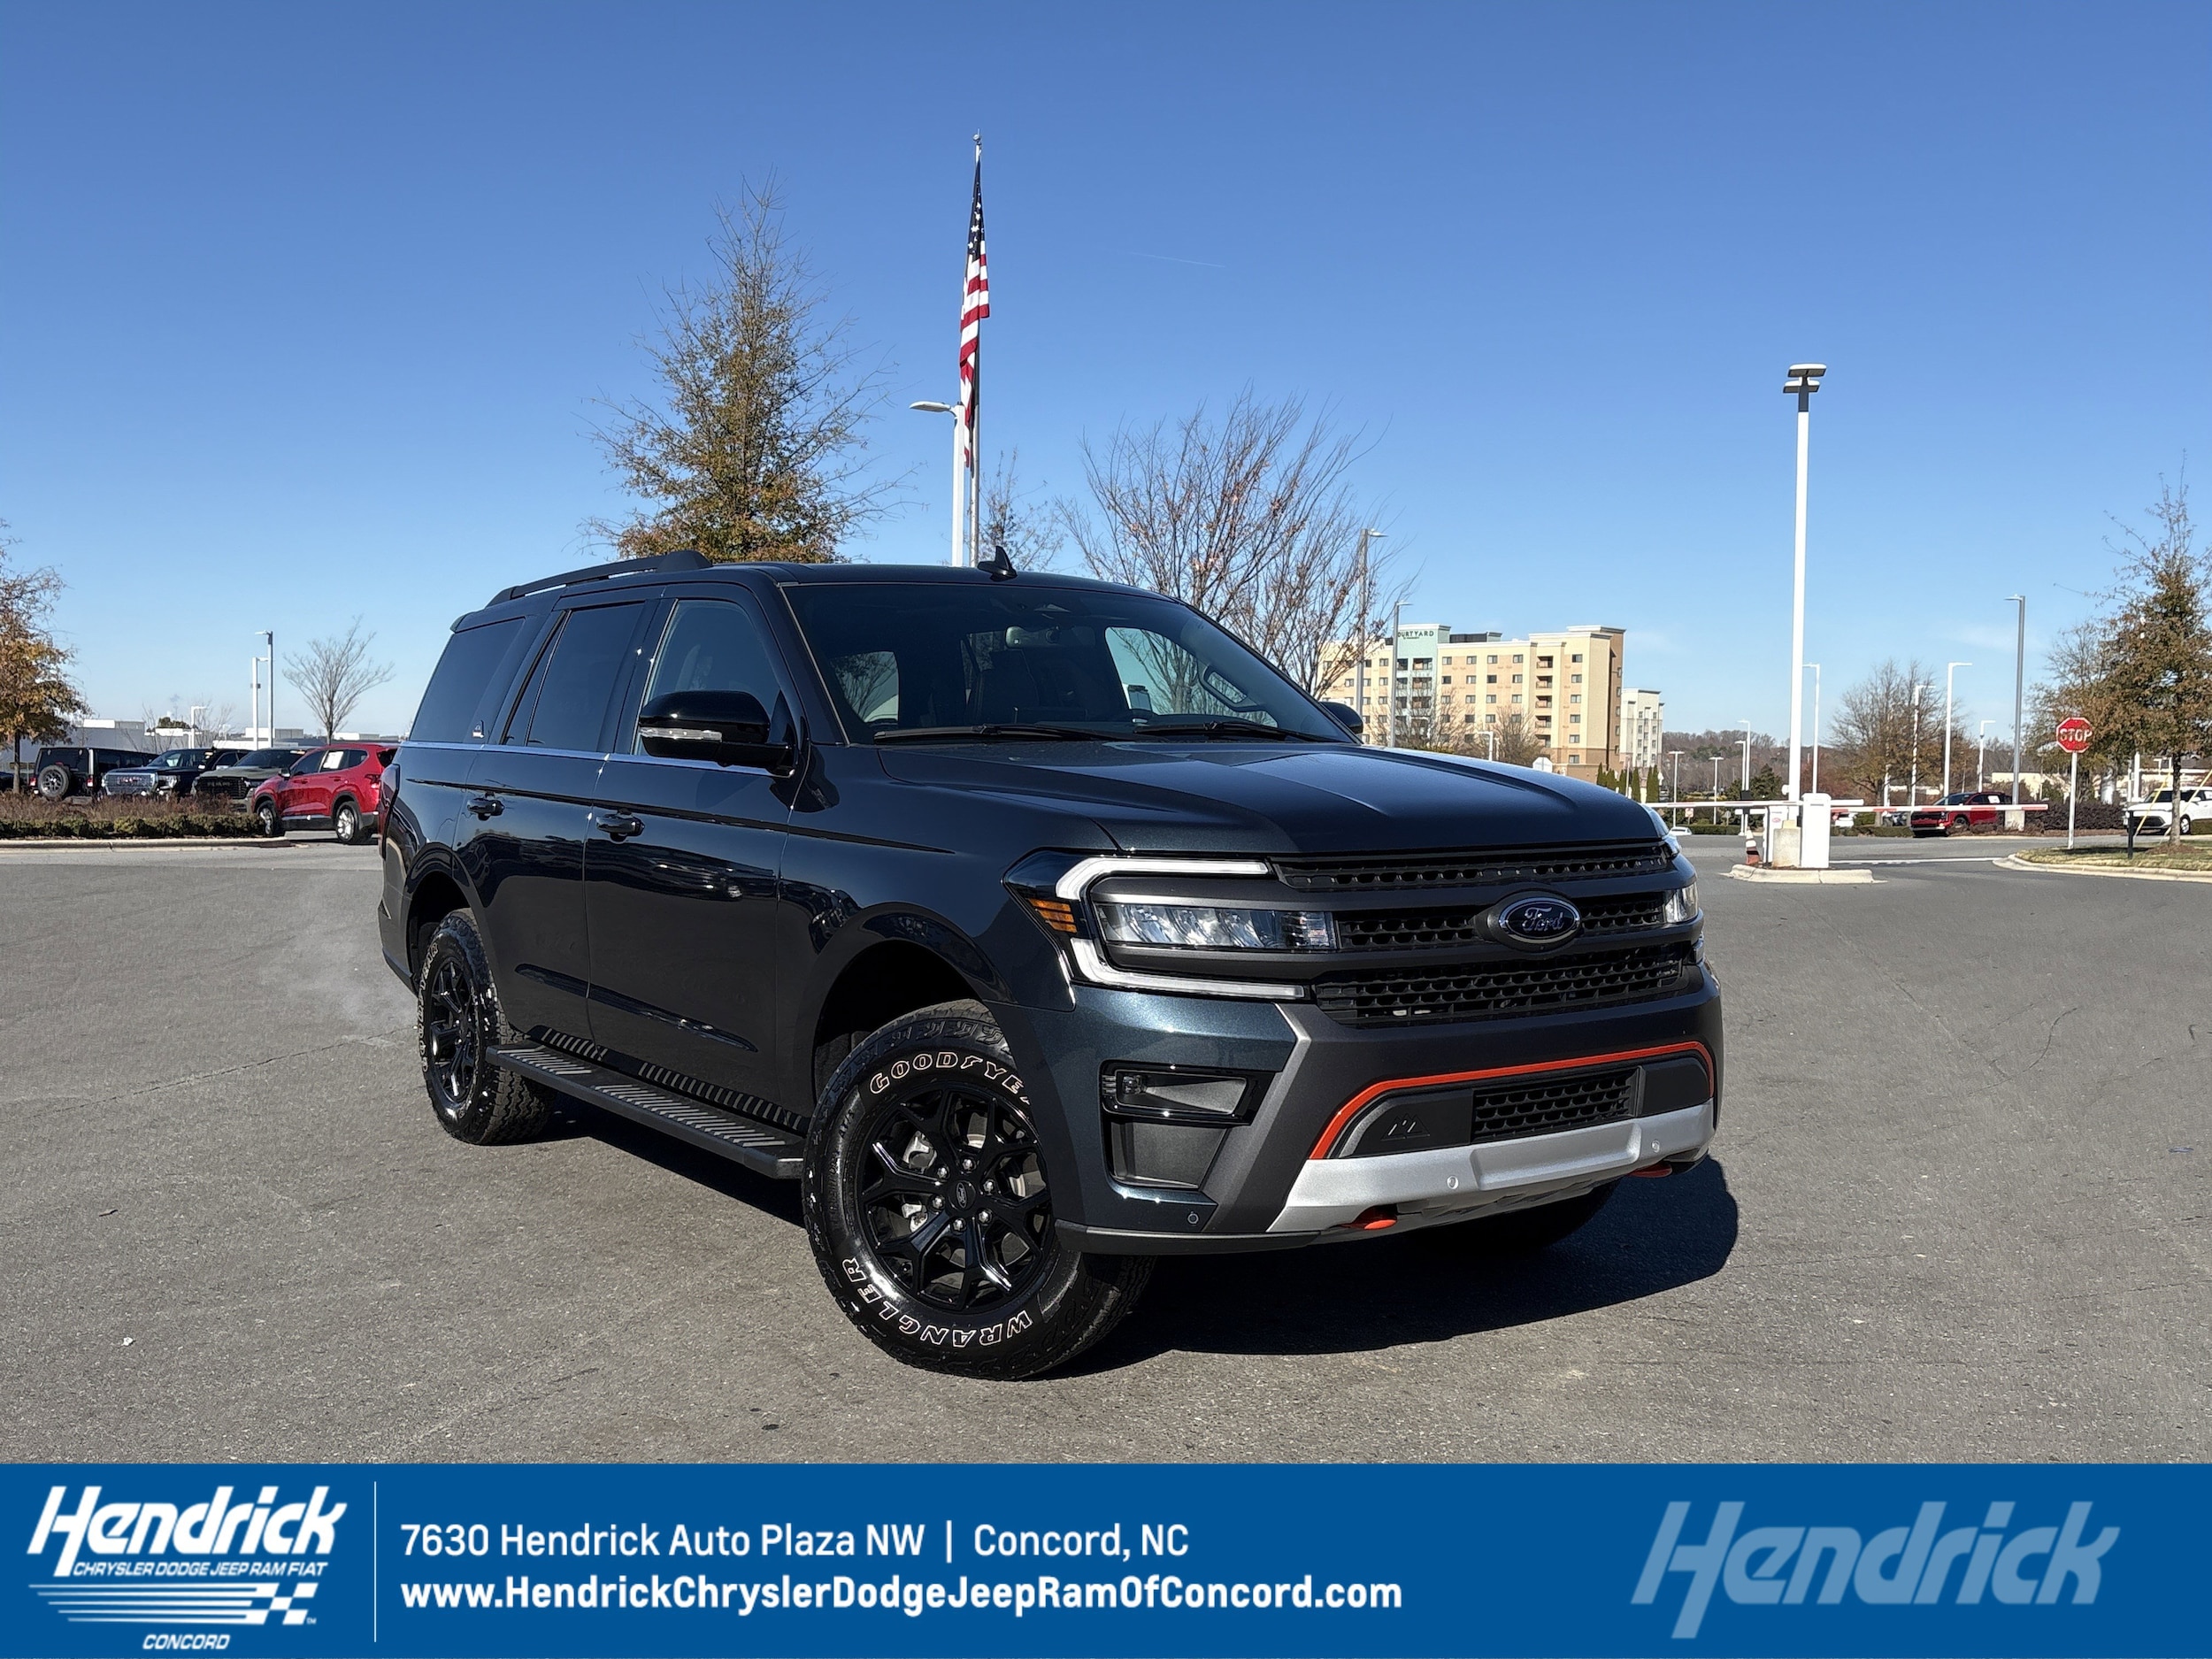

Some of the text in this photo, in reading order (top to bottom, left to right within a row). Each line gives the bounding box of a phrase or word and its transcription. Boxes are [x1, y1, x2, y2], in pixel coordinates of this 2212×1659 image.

[2060, 728, 2093, 741] STOP
[1522, 907, 1564, 932] Ford
[841, 1256, 1034, 1348] WRANGLER
